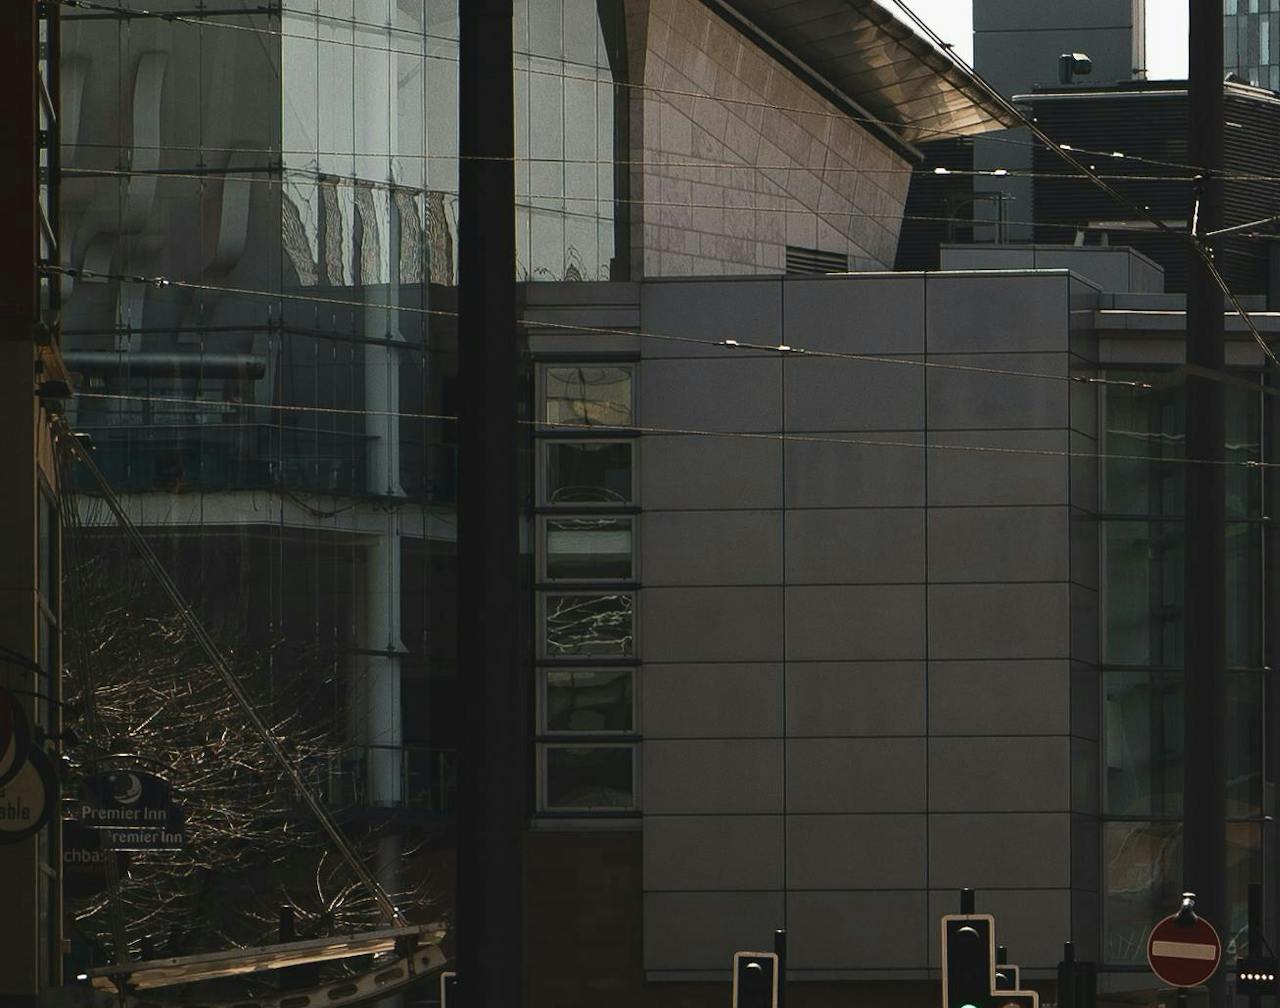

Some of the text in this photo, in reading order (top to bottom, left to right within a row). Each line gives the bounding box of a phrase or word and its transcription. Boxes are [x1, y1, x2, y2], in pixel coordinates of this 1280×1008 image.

[82, 805, 167, 820] Premier Inn
[106, 830, 183, 844] remier Inn
